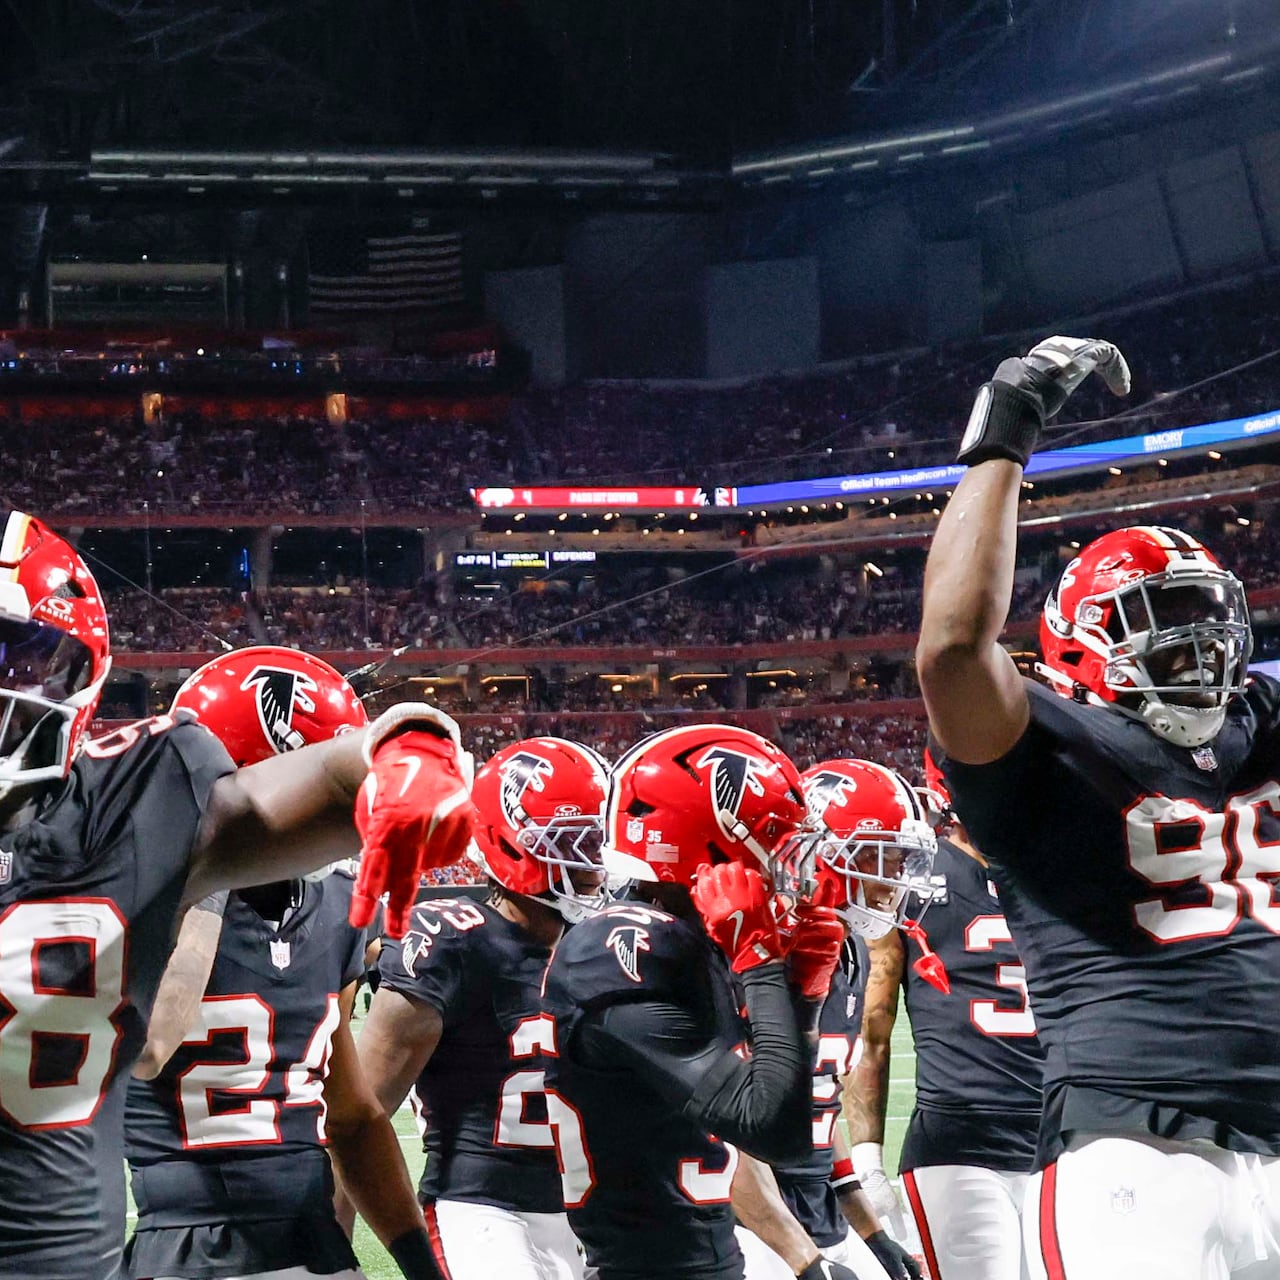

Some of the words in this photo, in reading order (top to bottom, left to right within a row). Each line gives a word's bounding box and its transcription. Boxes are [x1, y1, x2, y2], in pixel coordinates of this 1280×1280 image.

[1244, 417, 1275, 433] Official
[1144, 431, 1184, 447] EMORY
[840, 478, 873, 491] Official
[874, 475, 900, 488] Team
[40, 604, 75, 624] OAKLEY
[647, 830, 662, 843] 35
[177, 992, 341, 1149] 24
